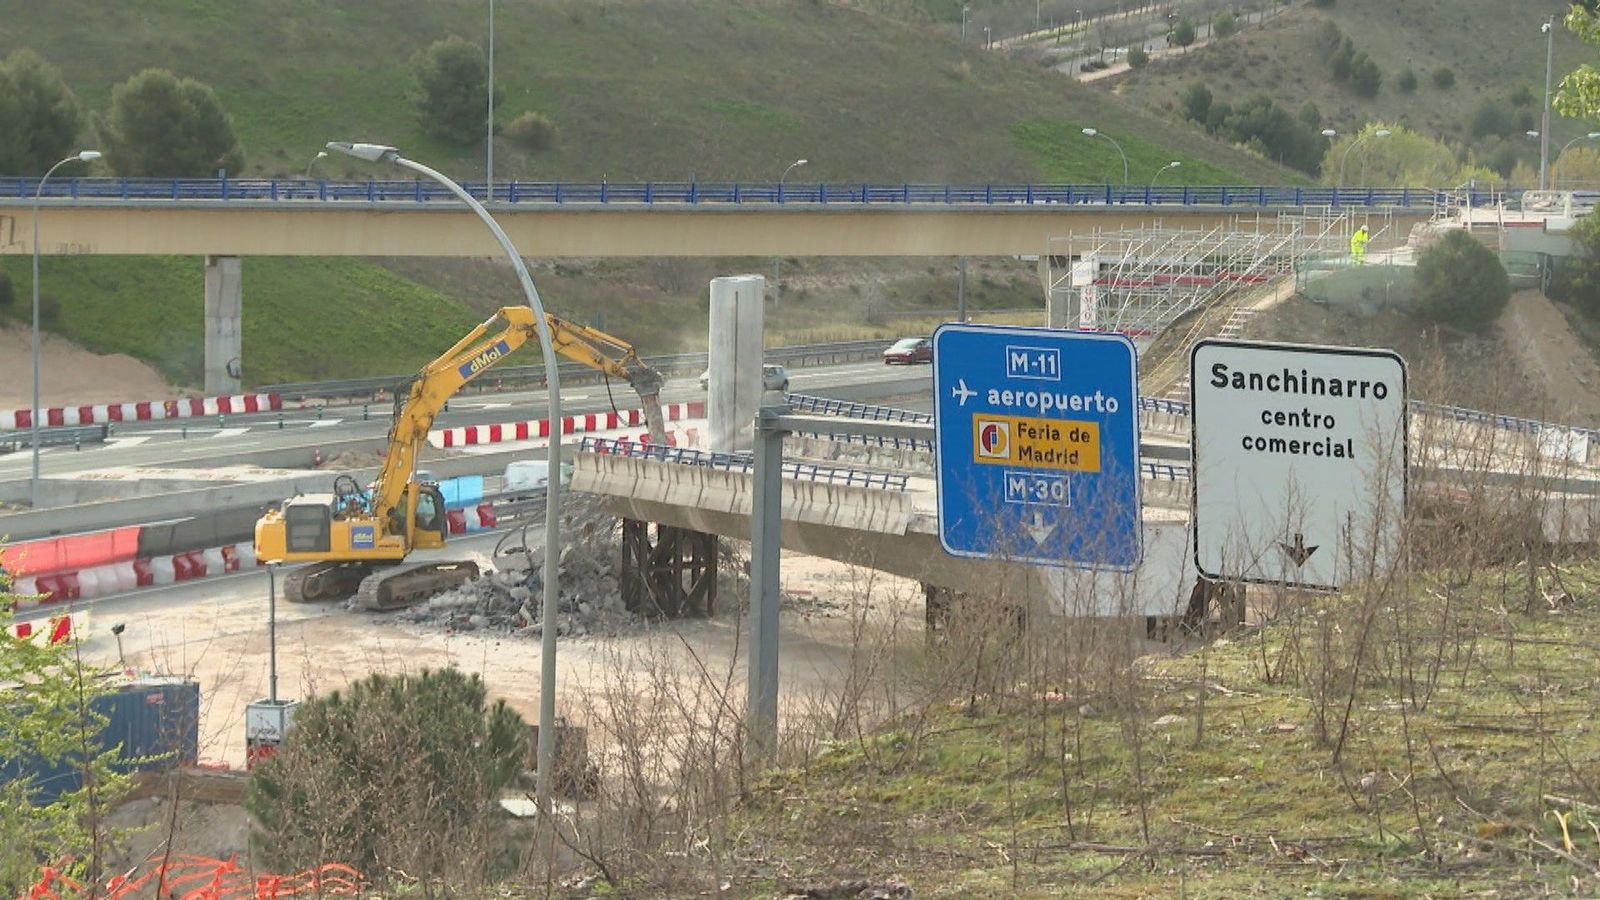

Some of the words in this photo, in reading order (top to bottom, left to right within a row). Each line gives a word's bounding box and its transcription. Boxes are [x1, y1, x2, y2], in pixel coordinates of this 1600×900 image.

[470, 346, 501, 372] dMol
[1011, 352, 1056, 374] M-11
[1210, 363, 1388, 400] Sanchinarro
[987, 388, 1119, 414] aeropuerto
[1261, 408, 1335, 429] centro
[1017, 422, 1060, 441] Feria
[1069, 427, 1090, 443] de
[1018, 445, 1079, 465] Madrid
[1242, 436, 1355, 459] comercial
[1009, 477, 1064, 500] M-30
